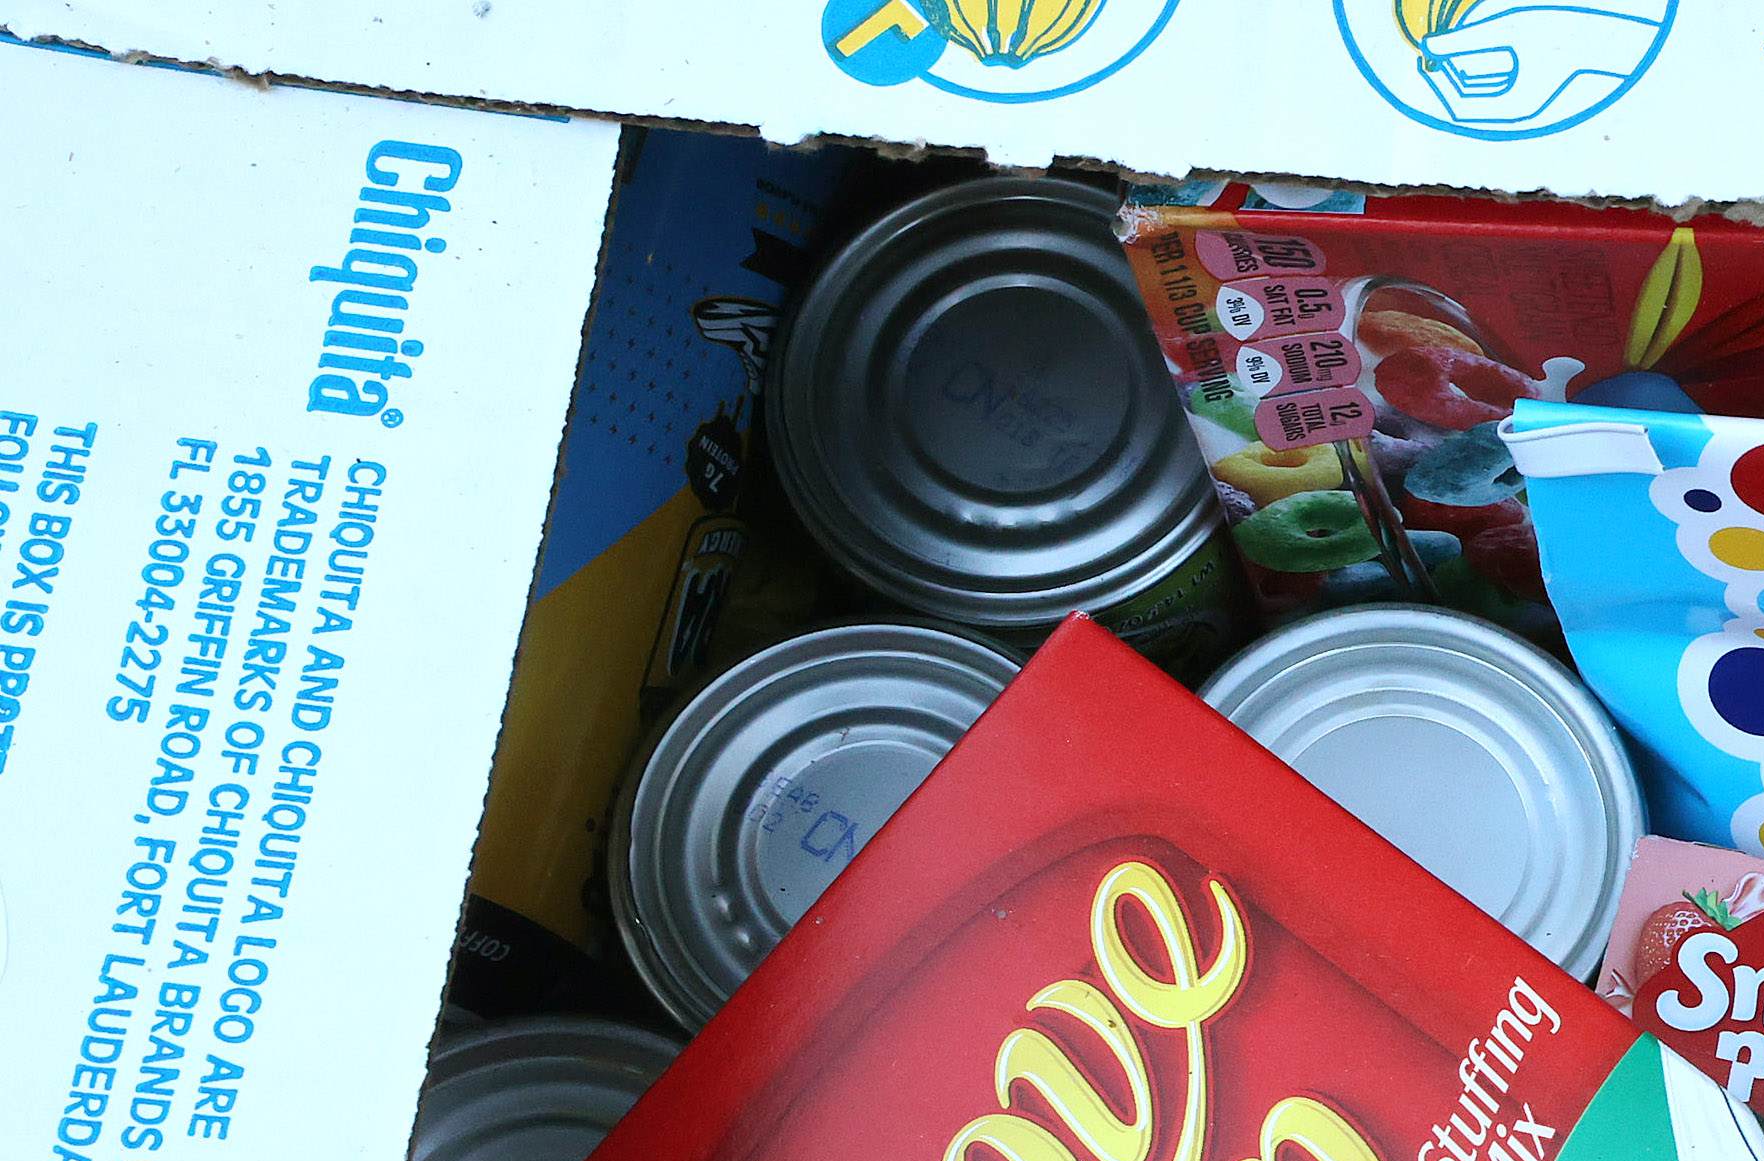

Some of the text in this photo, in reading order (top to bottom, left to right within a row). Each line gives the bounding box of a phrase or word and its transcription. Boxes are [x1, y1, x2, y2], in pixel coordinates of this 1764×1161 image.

[307, 140, 463, 417] Chiquita
[1152, 231, 1185, 264] PER
[1163, 274, 1198, 303] 1/3
[1174, 300, 1213, 336] CUP
[1226, 297, 1252, 327] 3% DV
[1263, 284, 1296, 326] SAT FAT
[1187, 337, 1234, 403] SERVING
[1245, 355, 1271, 385] 9% DV
[1281, 343, 1313, 385] SODIUM
[1276, 402, 1306, 443] SUGARS
[1301, 402, 1326, 433] TOTAL
[36, 421, 98, 506] THIS
[215, 446, 273, 543] 1855
[11, 511, 73, 595] BOX
[105, 436, 218, 724] FL 33004-2275
[233, 454, 332, 713] TRADEMARKS
[0, 600, 49, 637] IS
[175, 552, 247, 698] GRIFFIN
[133, 703, 211, 825] ROAD,
[221, 720, 265, 776] OF
[186, 460, 388, 1141] CHIQUITA AND CHIQUITA LOGO ARE
[111, 835, 177, 946] FORT
[167, 782, 251, 969] CHIQUITA
[120, 981, 202, 1152] BRANDS
